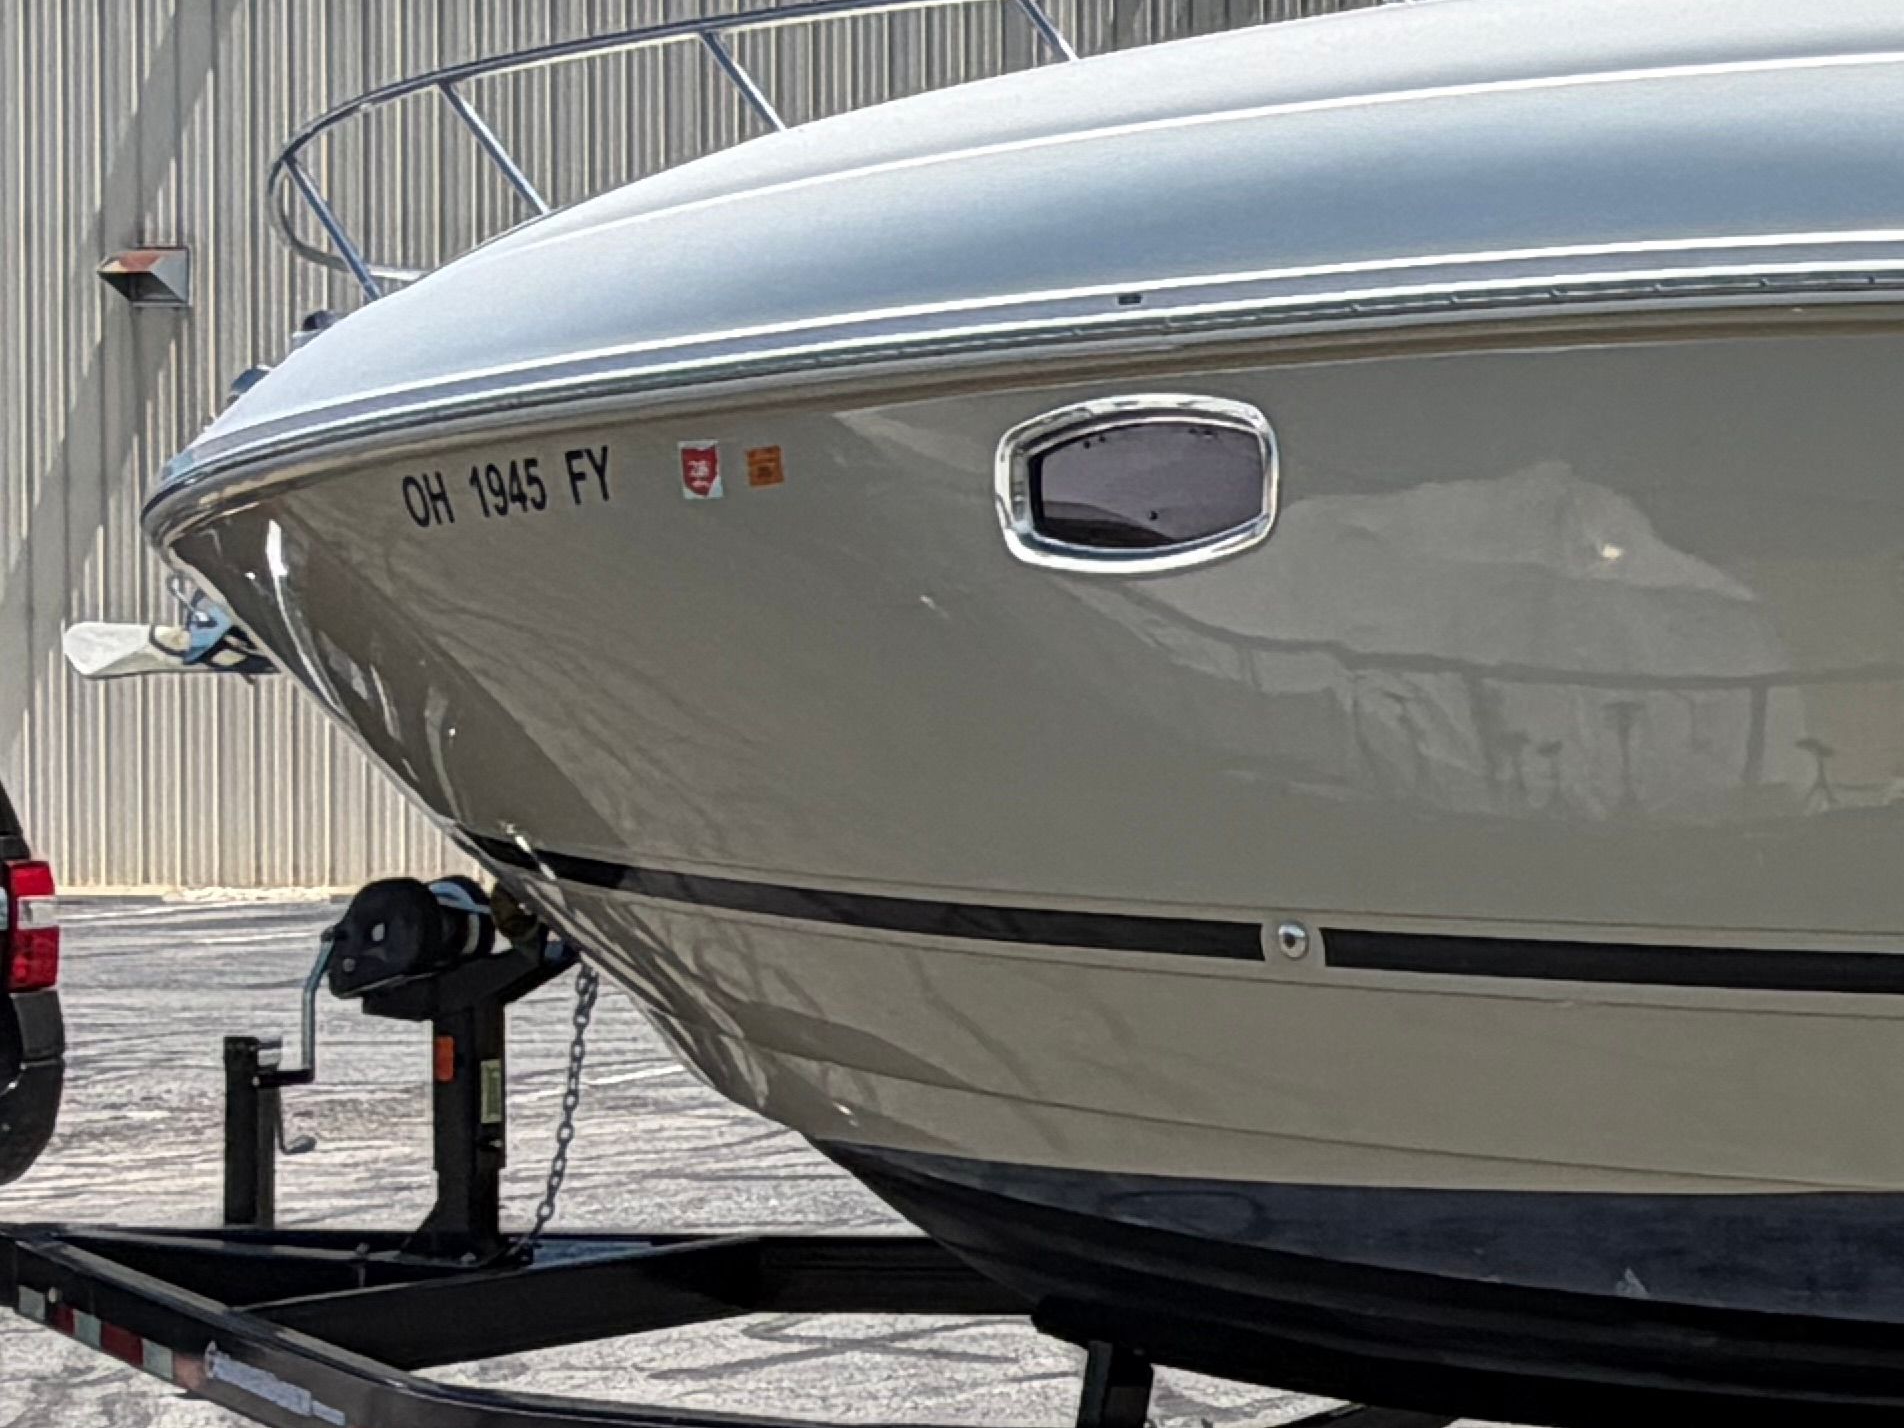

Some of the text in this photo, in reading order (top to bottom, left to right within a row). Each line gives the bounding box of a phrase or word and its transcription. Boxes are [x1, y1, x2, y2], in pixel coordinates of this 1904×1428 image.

[401, 444, 611, 529] OH 1945 FY
